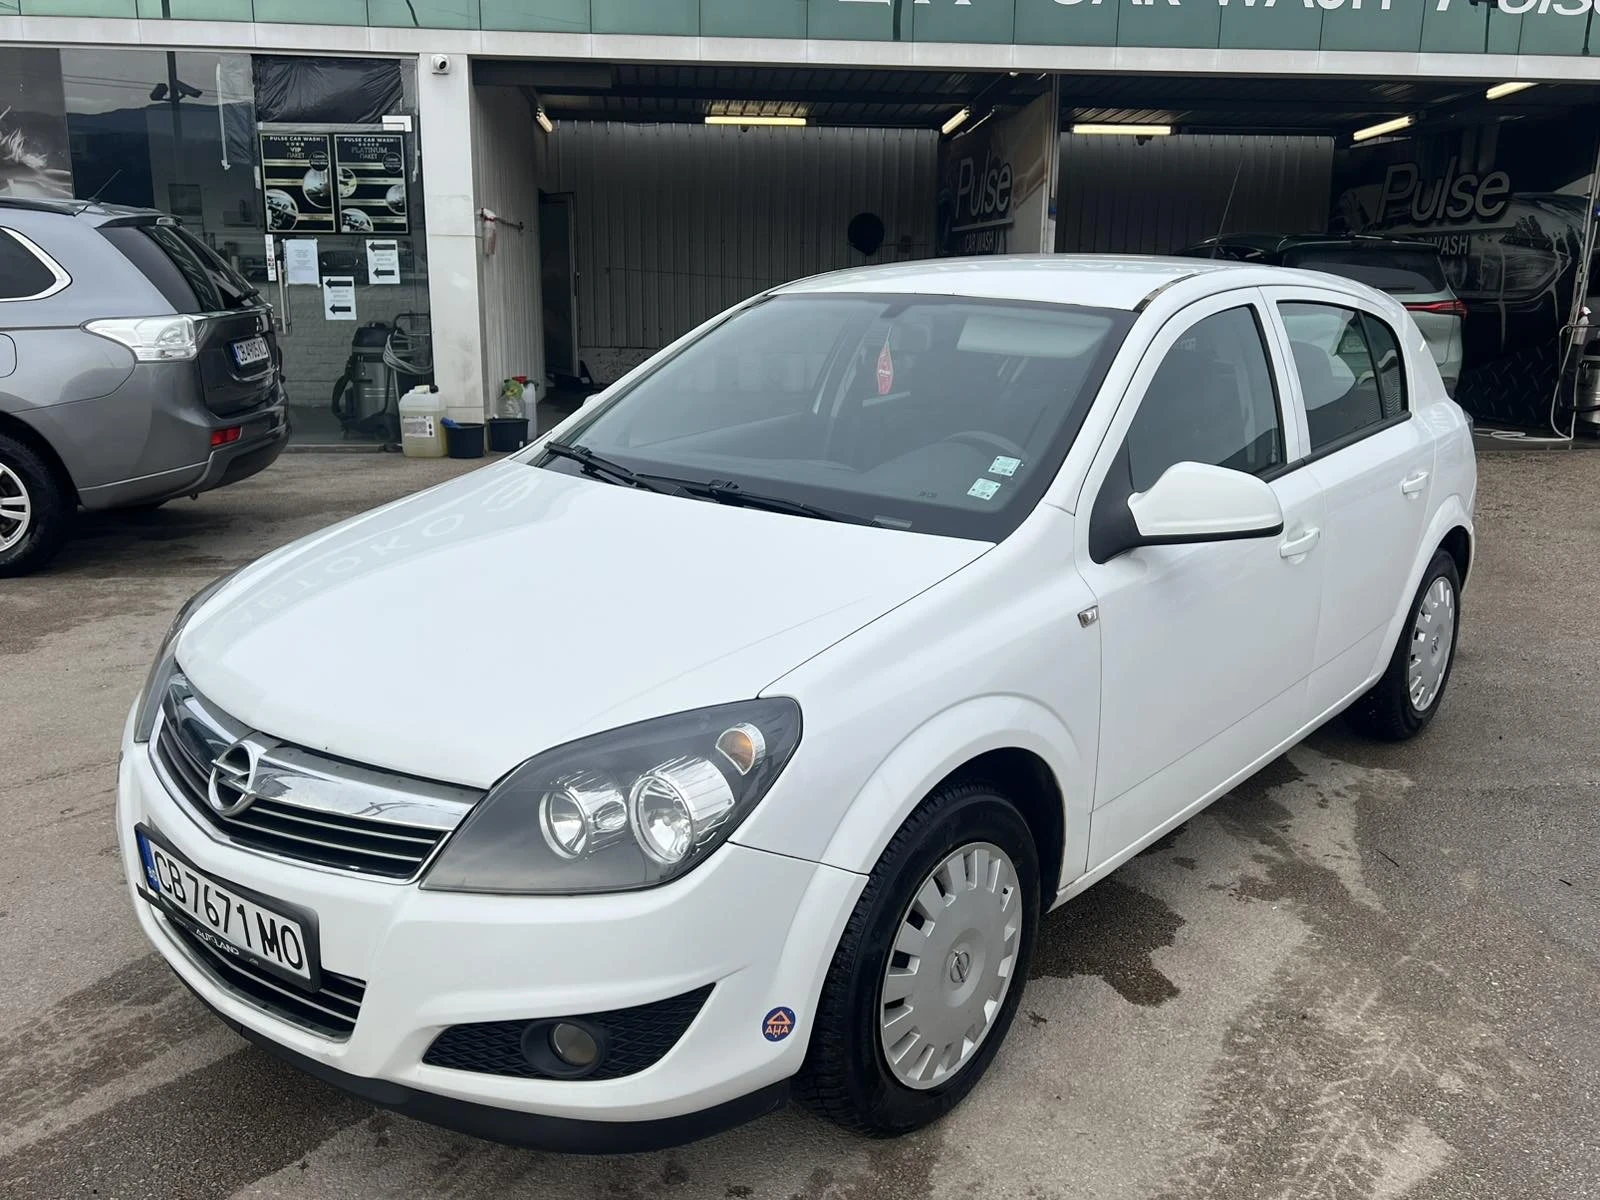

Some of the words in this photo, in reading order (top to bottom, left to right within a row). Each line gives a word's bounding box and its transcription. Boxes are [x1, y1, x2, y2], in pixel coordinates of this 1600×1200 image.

[956, 150, 1012, 219] Pulse
[1376, 156, 1511, 223] Pulse
[154, 850, 303, 970] CB7671MO
